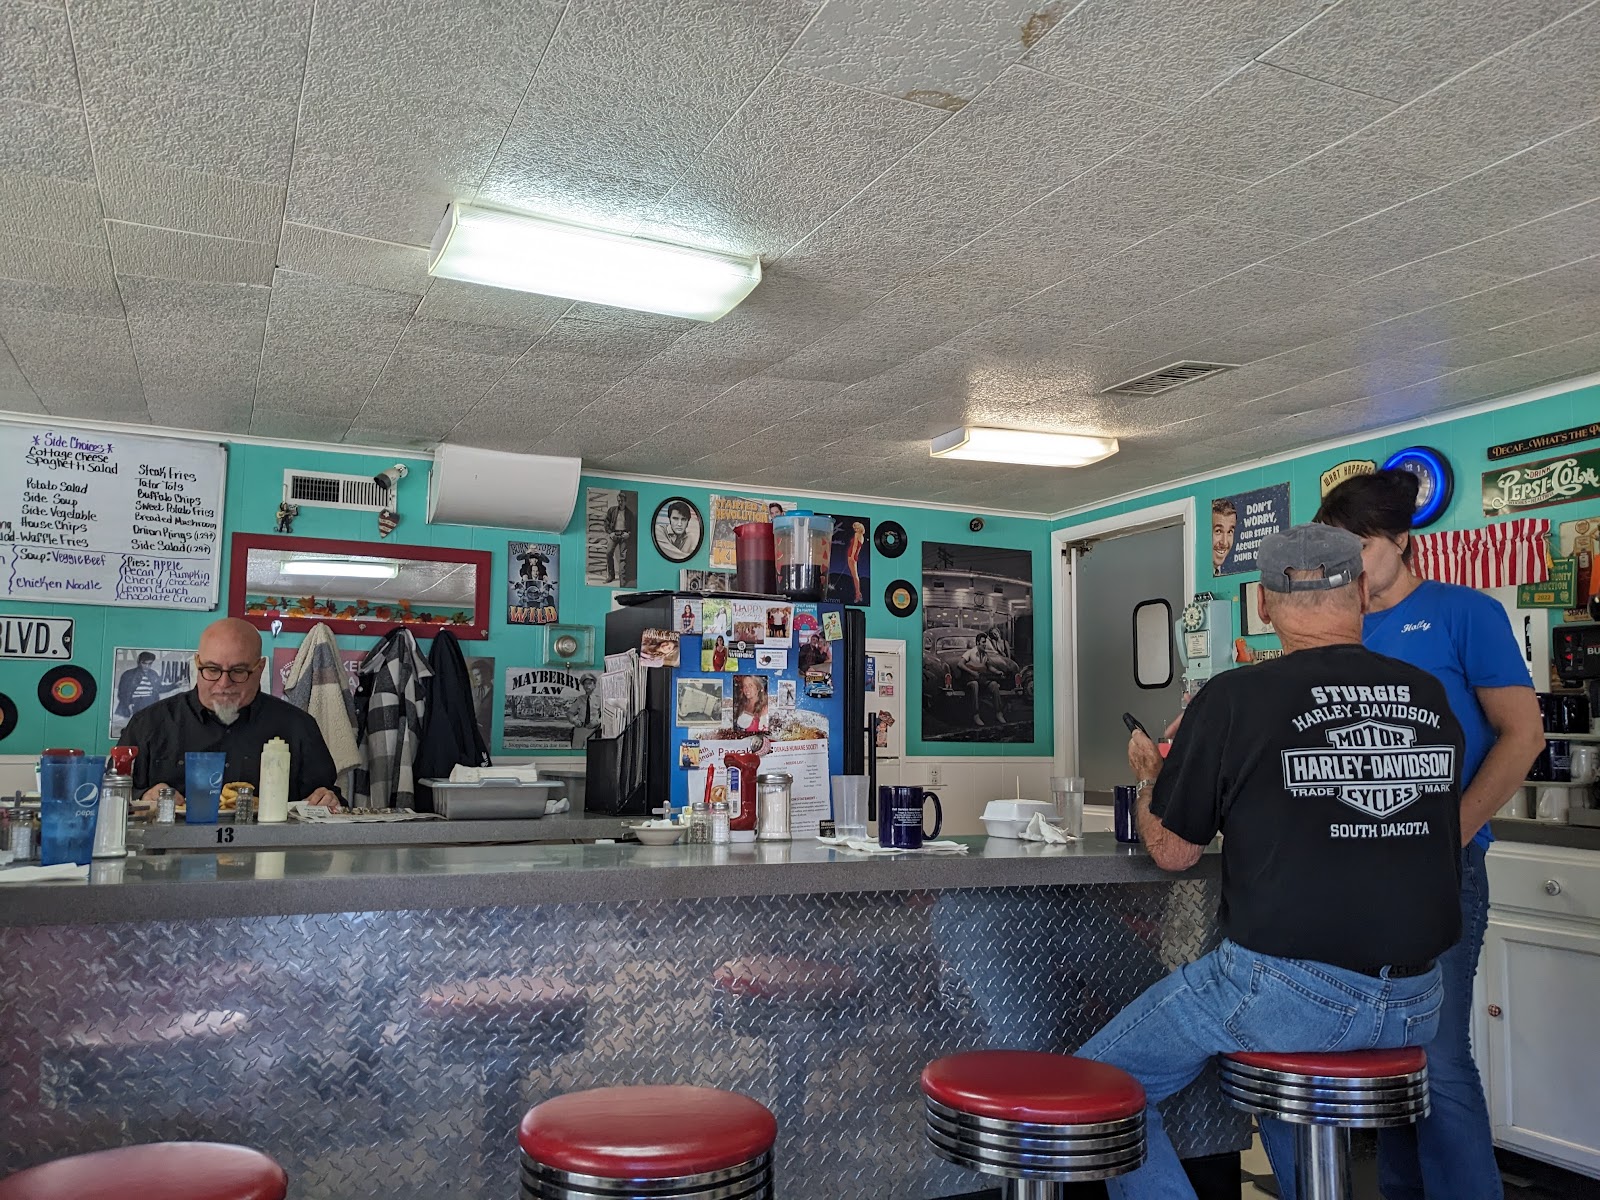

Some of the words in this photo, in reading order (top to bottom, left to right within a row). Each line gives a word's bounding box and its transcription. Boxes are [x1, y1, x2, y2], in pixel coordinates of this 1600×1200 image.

[1569, 428, 1588, 440] THE
[44, 432, 67, 447] Side
[70, 436, 105, 453] Choices
[28, 446, 73, 460] Cottage
[75, 452, 109, 463] Cheese
[25, 454, 85, 470] Spaghetti
[87, 462, 118, 474] Salad
[138, 464, 166, 479] Steak
[169, 466, 197, 482] Fries
[1323, 469, 1341, 487] WHAT
[1529, 466, 1551, 478] DRINK
[26, 477, 58, 490] Potato
[60, 482, 88, 494] Salad
[162, 480, 184, 491] Tots
[23, 492, 48, 503] Side
[53, 493, 78, 507] Soup
[137, 488, 172, 502] Buffalo
[174, 493, 201, 507] Chips
[22, 504, 48, 516] Side
[50, 506, 98, 521] Vegetable
[135, 500, 164, 512] Sweet
[166, 503, 191, 515] Potato
[193, 506, 215, 518] Fries
[588, 491, 609, 532] DEAN
[715, 499, 759, 512] STARTED
[760, 503, 769, 512] A
[1246, 500, 1272, 515] DON'T
[135, 512, 172, 524] Breaded
[715, 509, 769, 523] REVOLUTION
[1243, 511, 1277, 528] WORRY,
[21, 516, 53, 529] House
[55, 520, 88, 534] Chips
[133, 525, 161, 537] Onion
[1240, 531, 1253, 540] OUR
[1254, 526, 1272, 538] STAFF
[1273, 525, 1280, 534] IS
[60, 534, 89, 548] Fries
[131, 539, 156, 551] Side
[157, 541, 186, 552] Salad
[84, 554, 106, 566] Beef
[588, 537, 608, 581] JAMES
[1233, 553, 1252, 563] DUMB
[124, 565, 154, 577] Pecan
[165, 569, 210, 580] Pumpkin
[16, 576, 62, 591] Chicken
[66, 579, 102, 590] Noodle
[122, 583, 153, 593] Lemon
[155, 585, 188, 595] Crunch
[125, 575, 162, 588] Cherry
[120, 592, 170, 601] Chocolate
[173, 594, 207, 603] Cream
[509, 605, 558, 624] WILD
[1401, 619, 1431, 633] Holly
[0, 620, 57, 654] LVD.
[1257, 651, 1268, 660] JUST
[512, 670, 580, 692] MAYBERRY
[531, 686, 564, 695] LAW
[1311, 685, 1411, 704] STURGIS
[1336, 724, 1407, 747] MOTOR
[1293, 752, 1449, 781] HARLEY-DAVIDSON
[1291, 787, 1335, 797] TRADE
[1425, 784, 1450, 793] MARK
[1347, 786, 1413, 812] CYCLES
[215, 827, 234, 843] 13
[1330, 824, 1378, 838] SOUTH
[1381, 821, 1430, 837] DAKOTA
